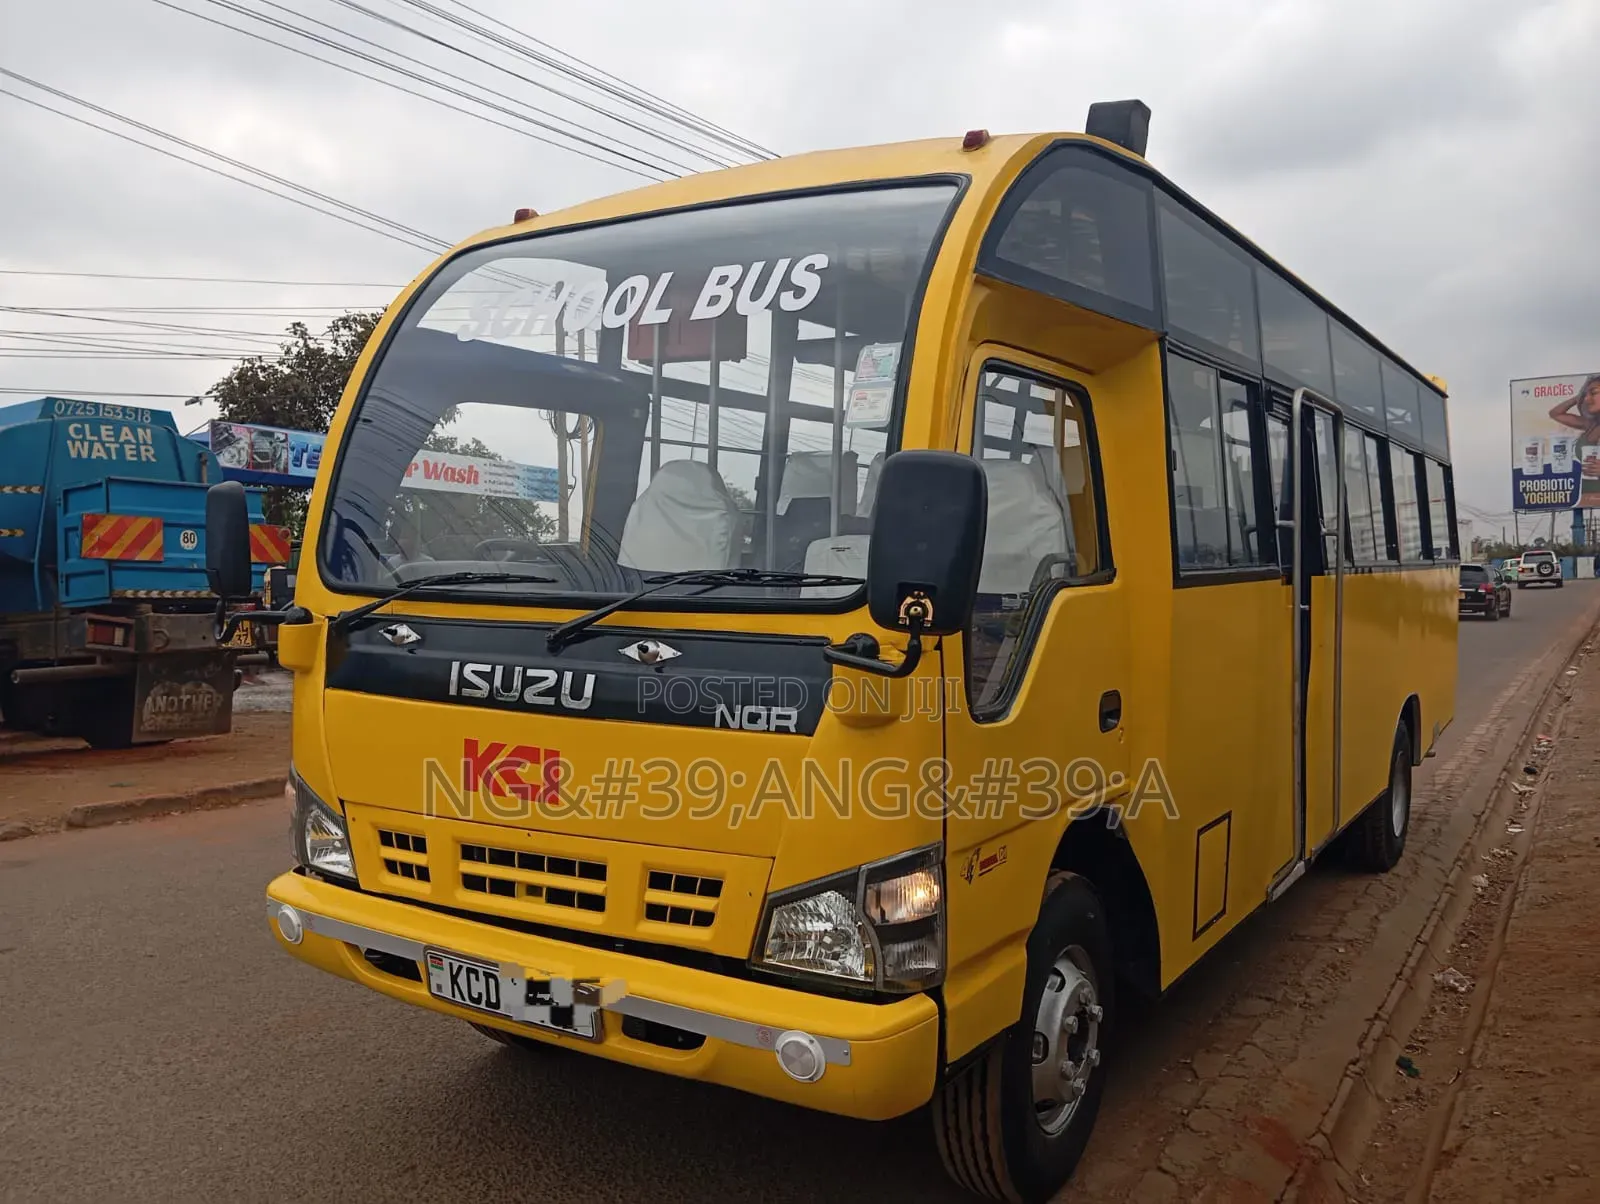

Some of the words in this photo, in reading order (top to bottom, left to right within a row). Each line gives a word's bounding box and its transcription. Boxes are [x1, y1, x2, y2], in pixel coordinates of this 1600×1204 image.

[457, 271, 674, 341] SCHOOL
[689, 253, 829, 321] BUS
[68, 423, 153, 444] CLEAN
[66, 440, 157, 462] WATER
[422, 459, 480, 485] Wash
[1520, 478, 1574, 493] PROBIOTIC
[1523, 491, 1572, 505] YOGHURT
[182, 531, 196, 544] 80
[449, 660, 596, 710] ISUZU
[715, 703, 798, 733] NQR
[449, 961, 500, 1010] KCD
